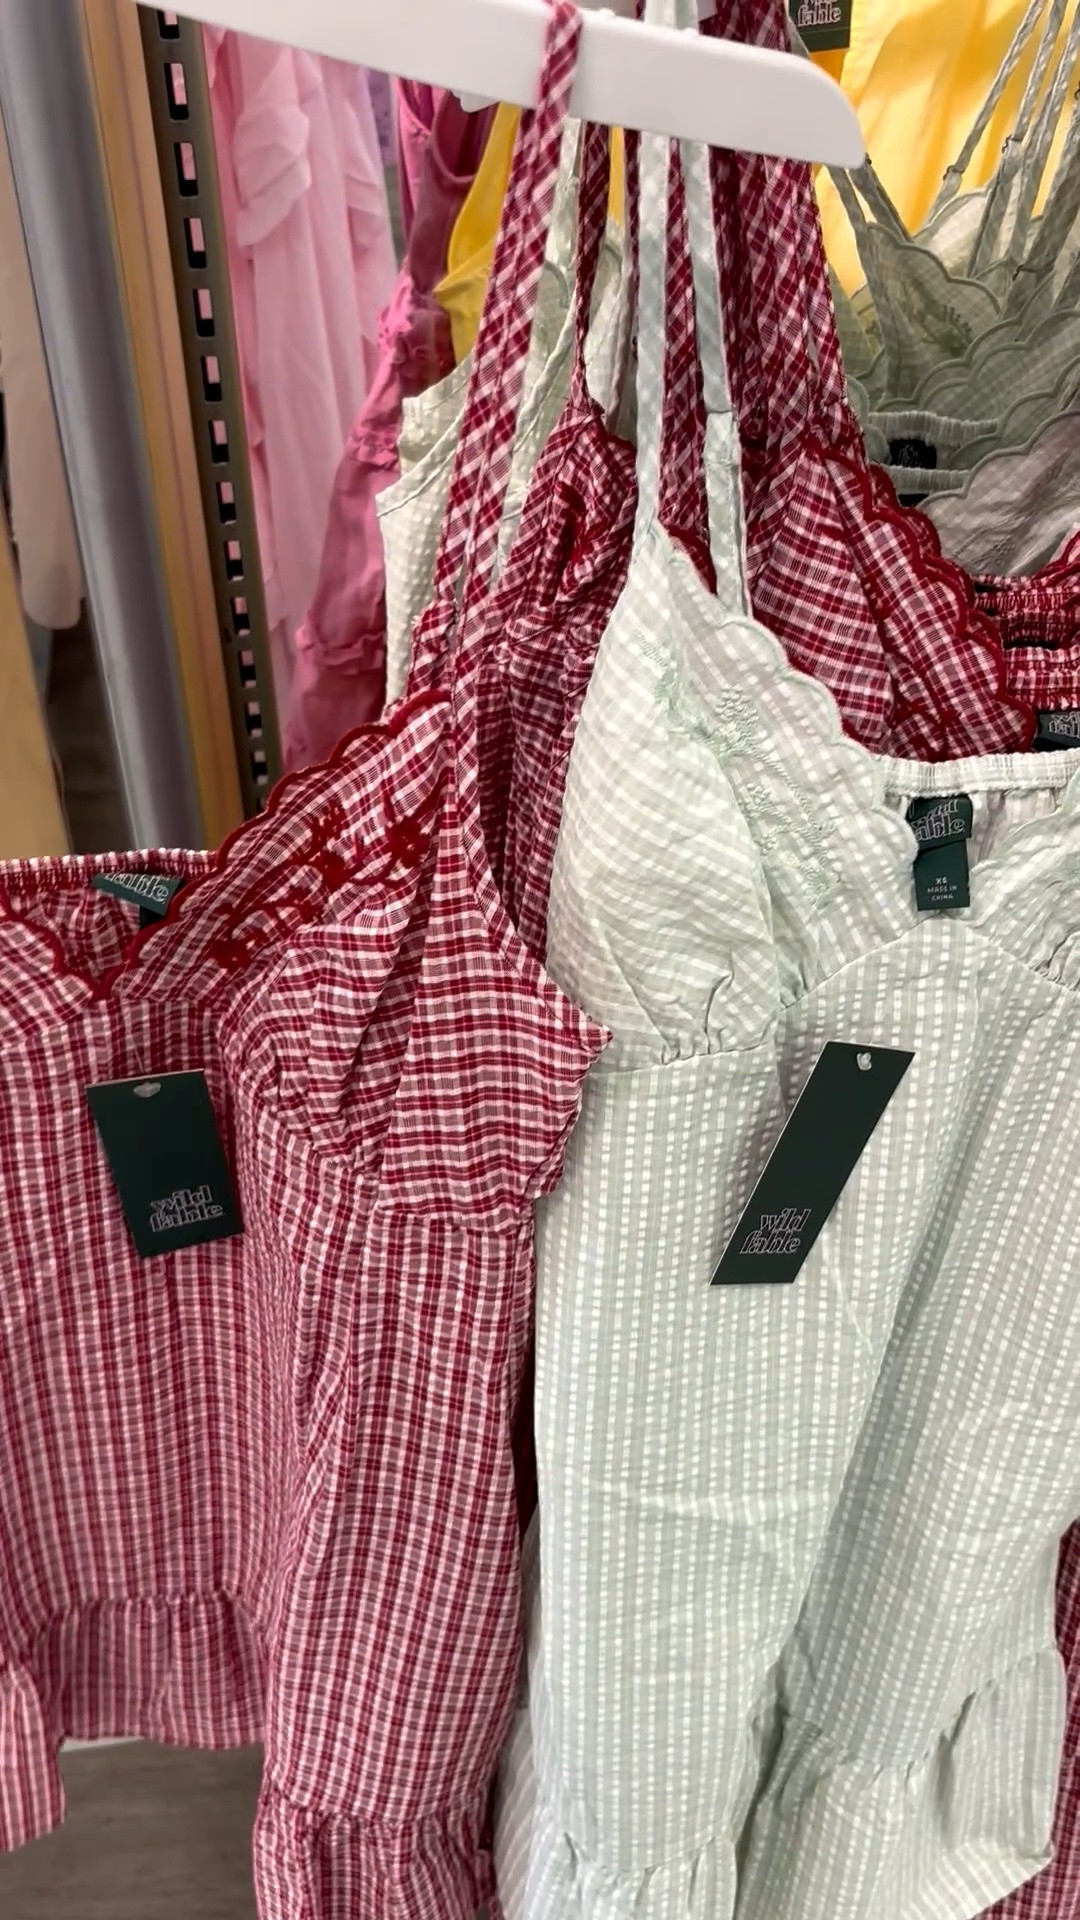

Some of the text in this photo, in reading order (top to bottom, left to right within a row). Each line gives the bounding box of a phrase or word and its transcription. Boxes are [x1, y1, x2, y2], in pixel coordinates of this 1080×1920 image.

[798, 4, 841, 27] fable
[915, 813, 965, 841] able
[931, 893, 954, 901] CHINA
[150, 1184, 213, 1214] wild
[150, 1202, 224, 1233] fable
[760, 1207, 812, 1232] wild
[739, 1229, 801, 1254] fable
